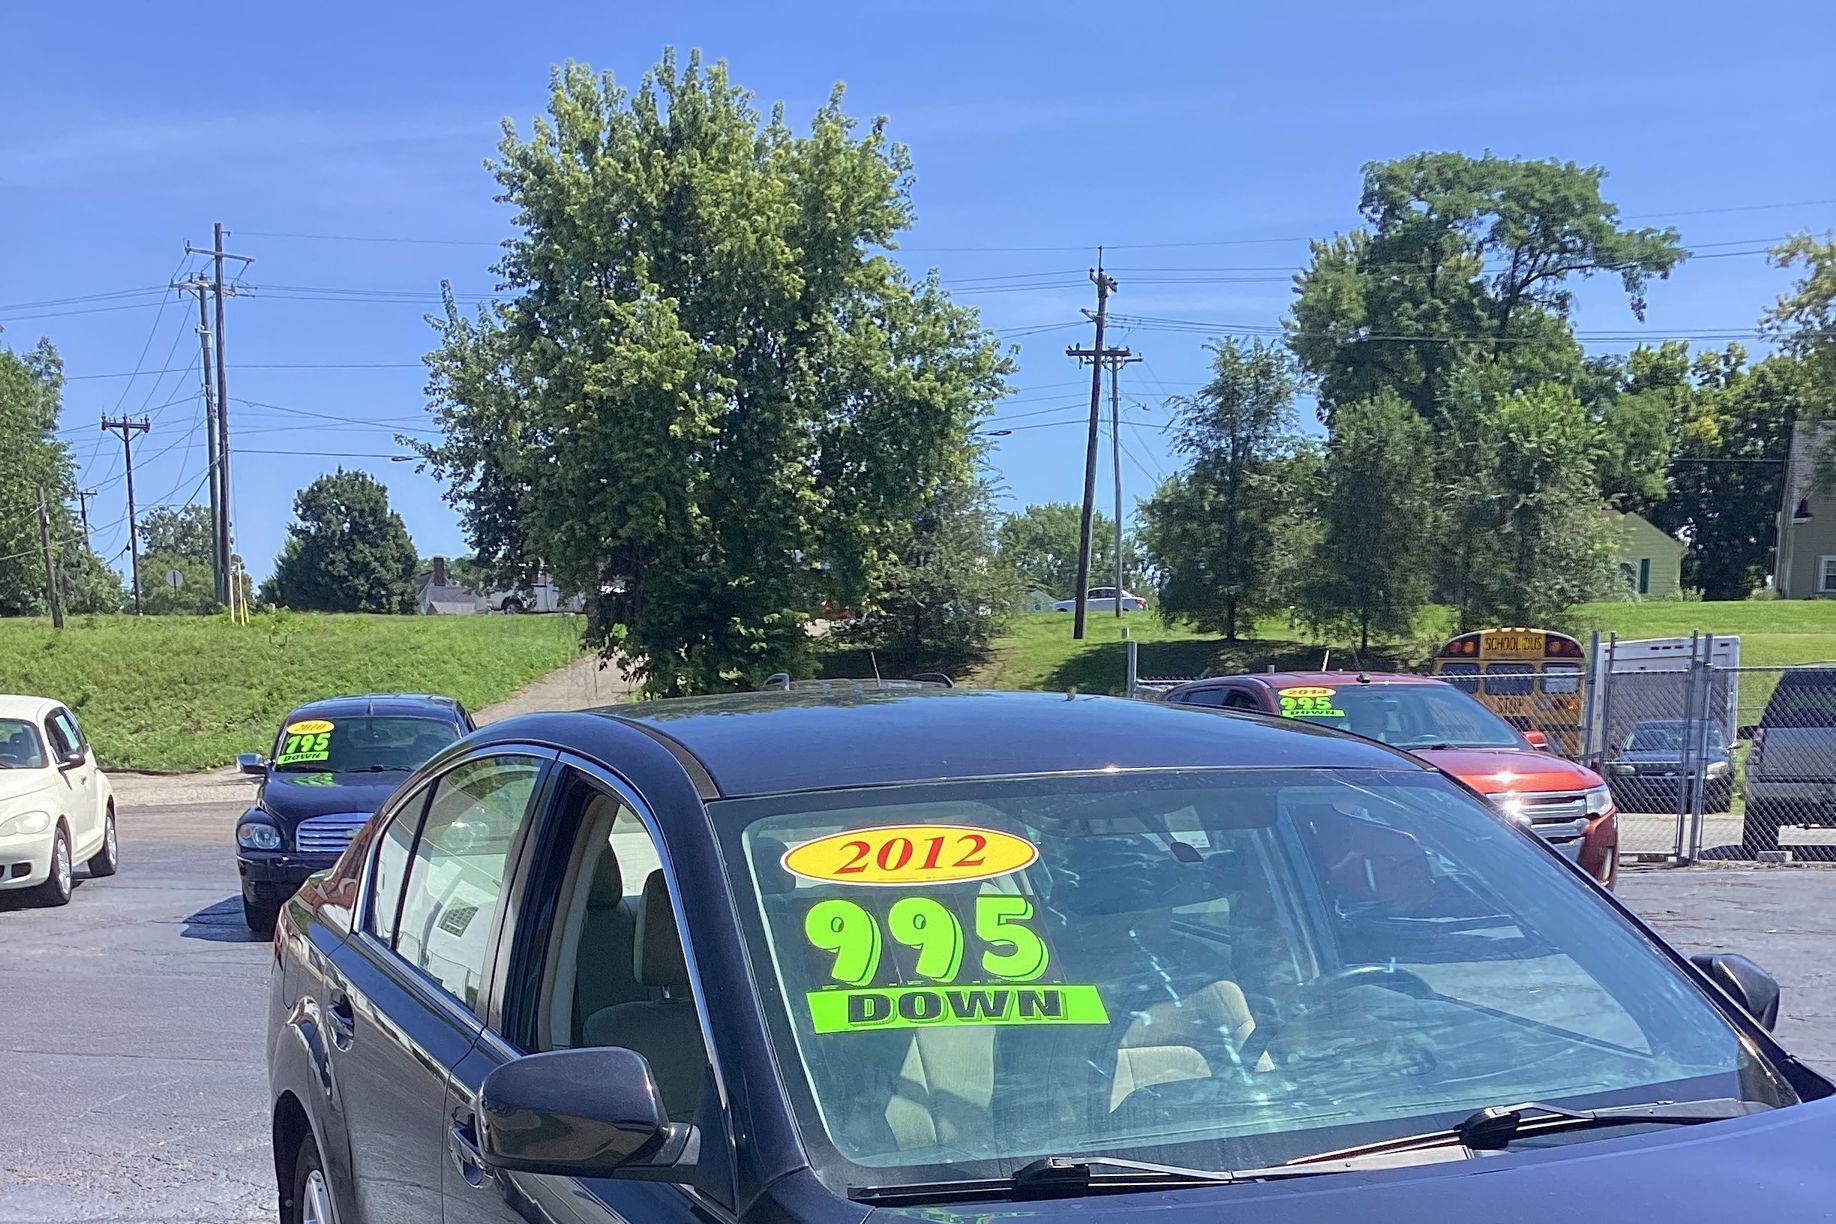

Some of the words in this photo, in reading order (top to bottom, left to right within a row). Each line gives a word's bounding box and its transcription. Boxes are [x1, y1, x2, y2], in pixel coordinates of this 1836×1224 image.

[1485, 637, 1519, 651] SCHOOL
[1280, 697, 1332, 710] 995
[283, 753, 321, 762] DOWN
[832, 834, 987, 875] 2012
[804, 894, 1050, 988] 995
[847, 990, 1069, 1025] DOWN
